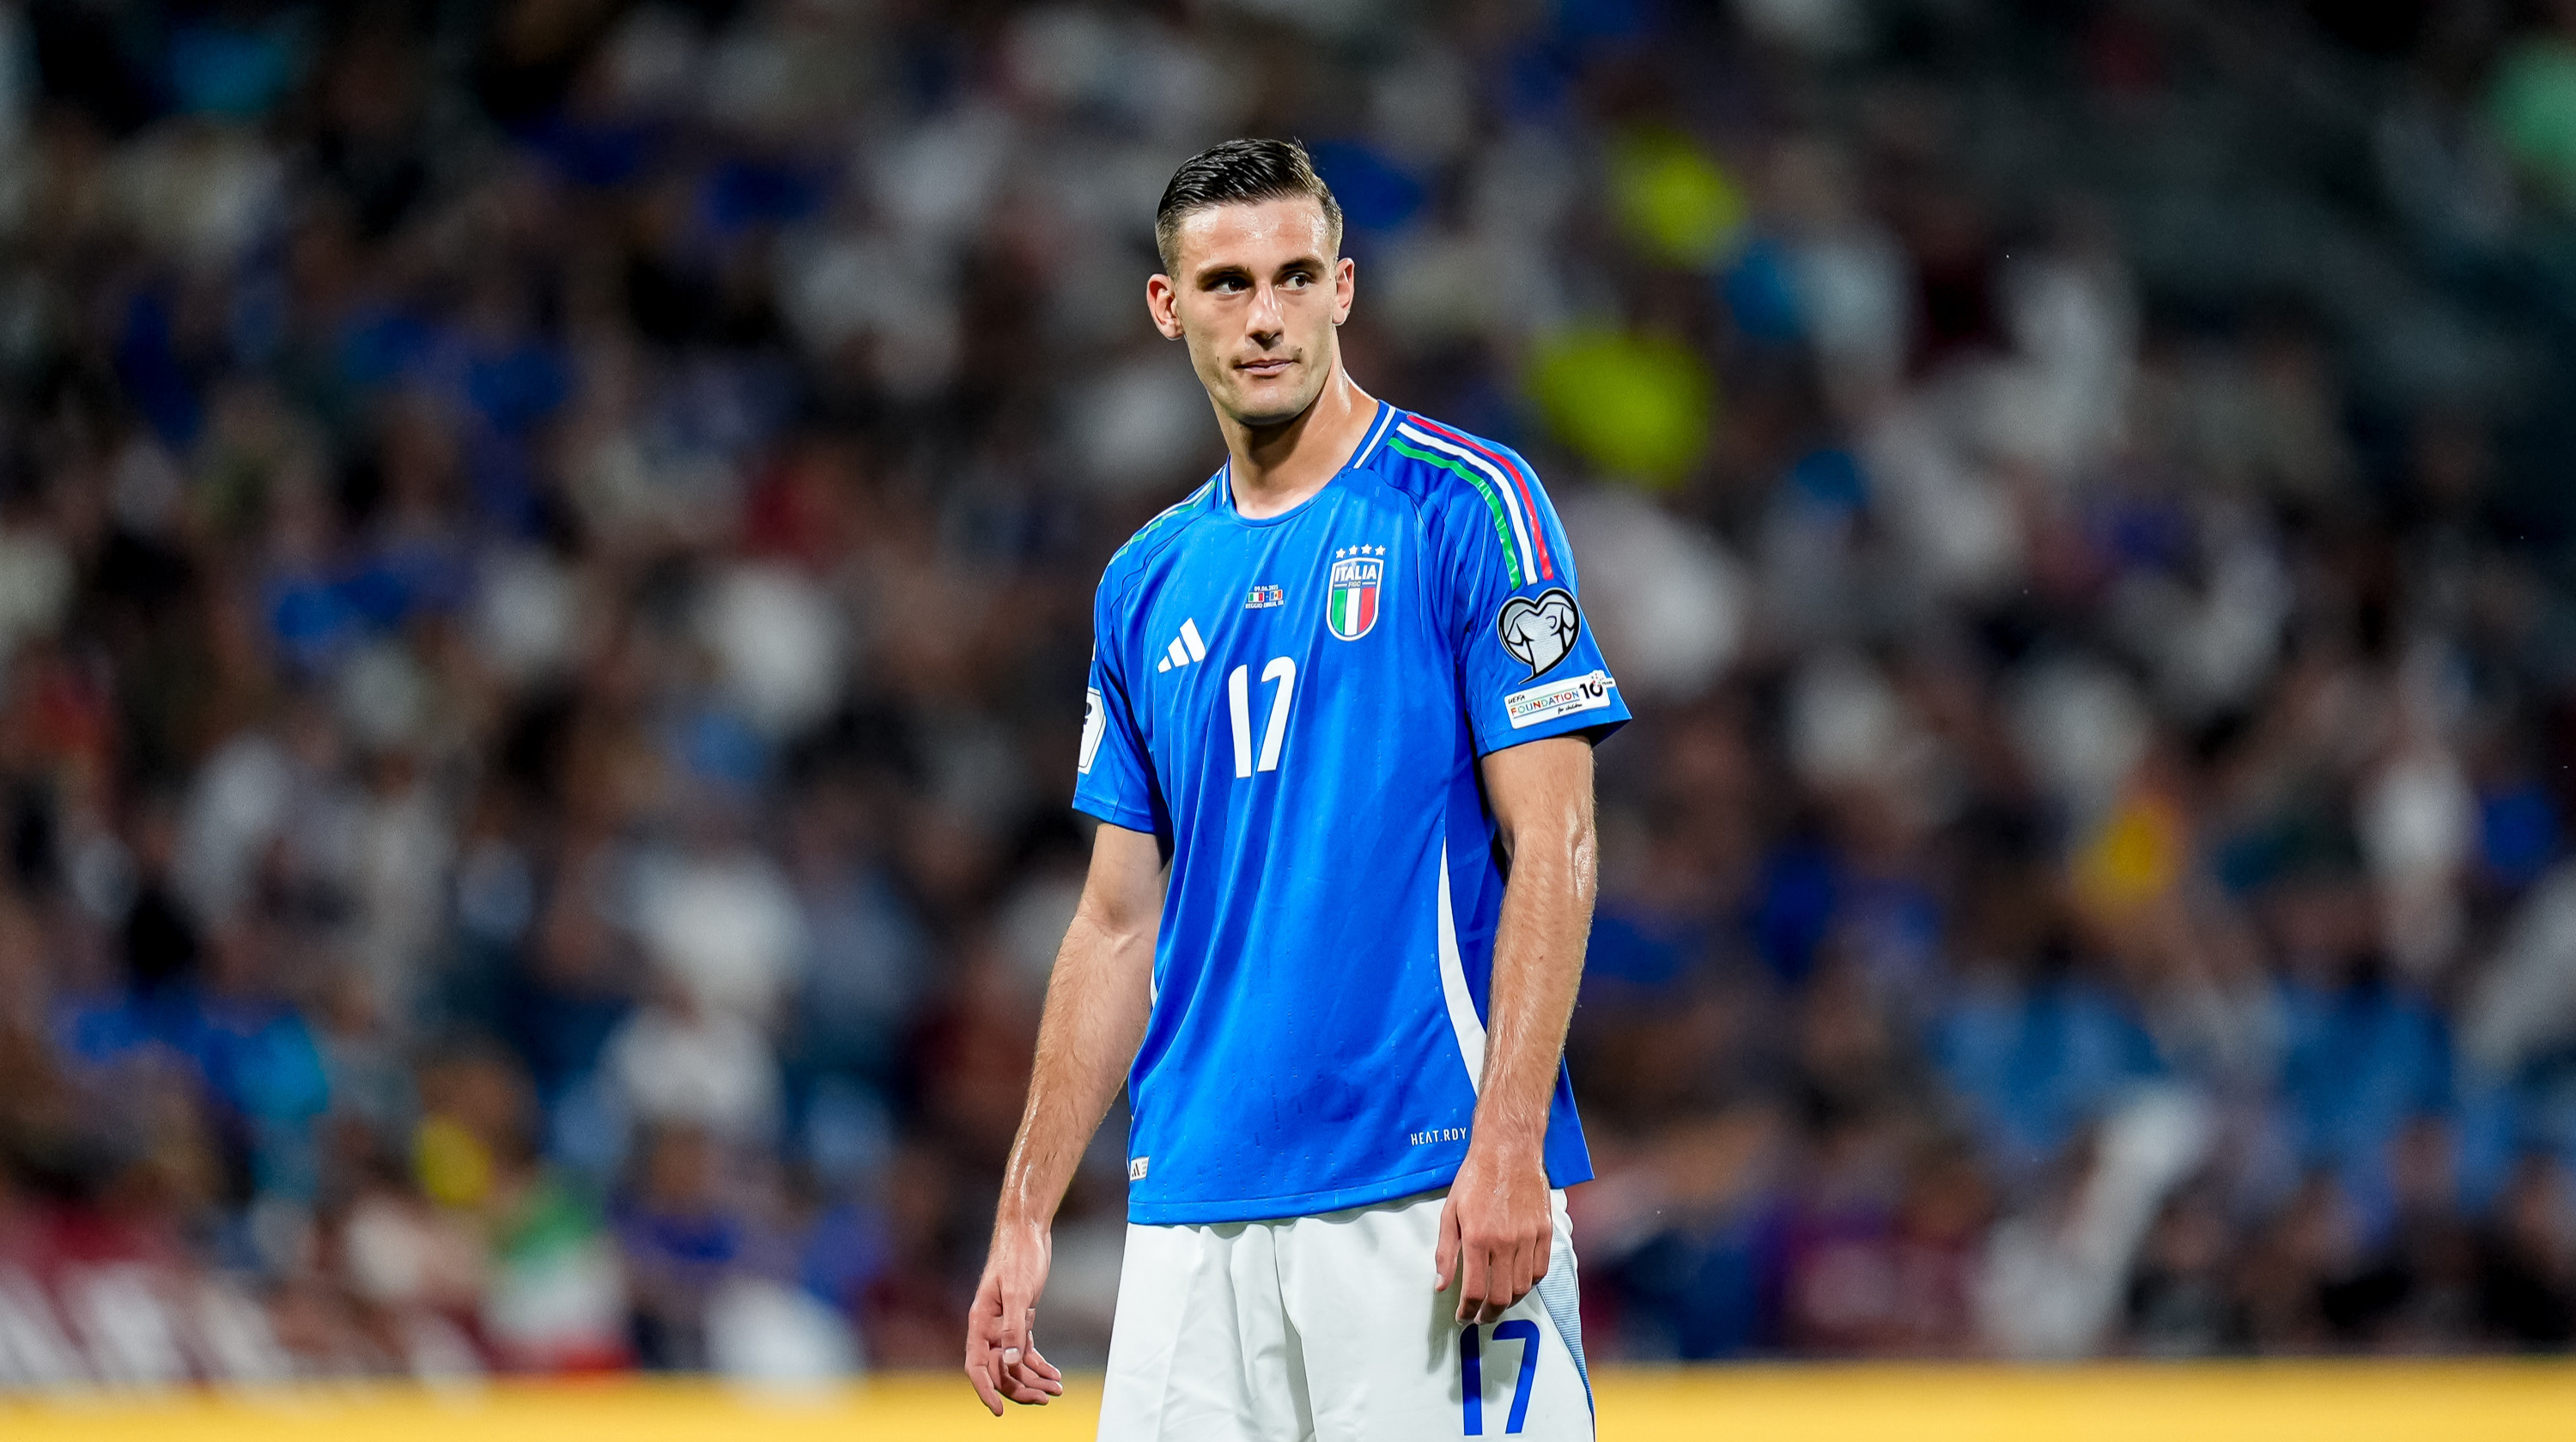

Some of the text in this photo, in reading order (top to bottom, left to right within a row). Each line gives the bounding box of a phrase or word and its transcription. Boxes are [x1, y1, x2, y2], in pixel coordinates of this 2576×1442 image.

[1335, 564, 1377, 582] ITALIA
[1508, 694, 1525, 704] UEFA
[1579, 679, 1603, 699] 10
[1511, 690, 1580, 716] FOUNDATION
[1229, 655, 1297, 778] 17
[1410, 1127, 1467, 1147] HEAT.RDY
[1460, 1318, 1540, 1436] 17
